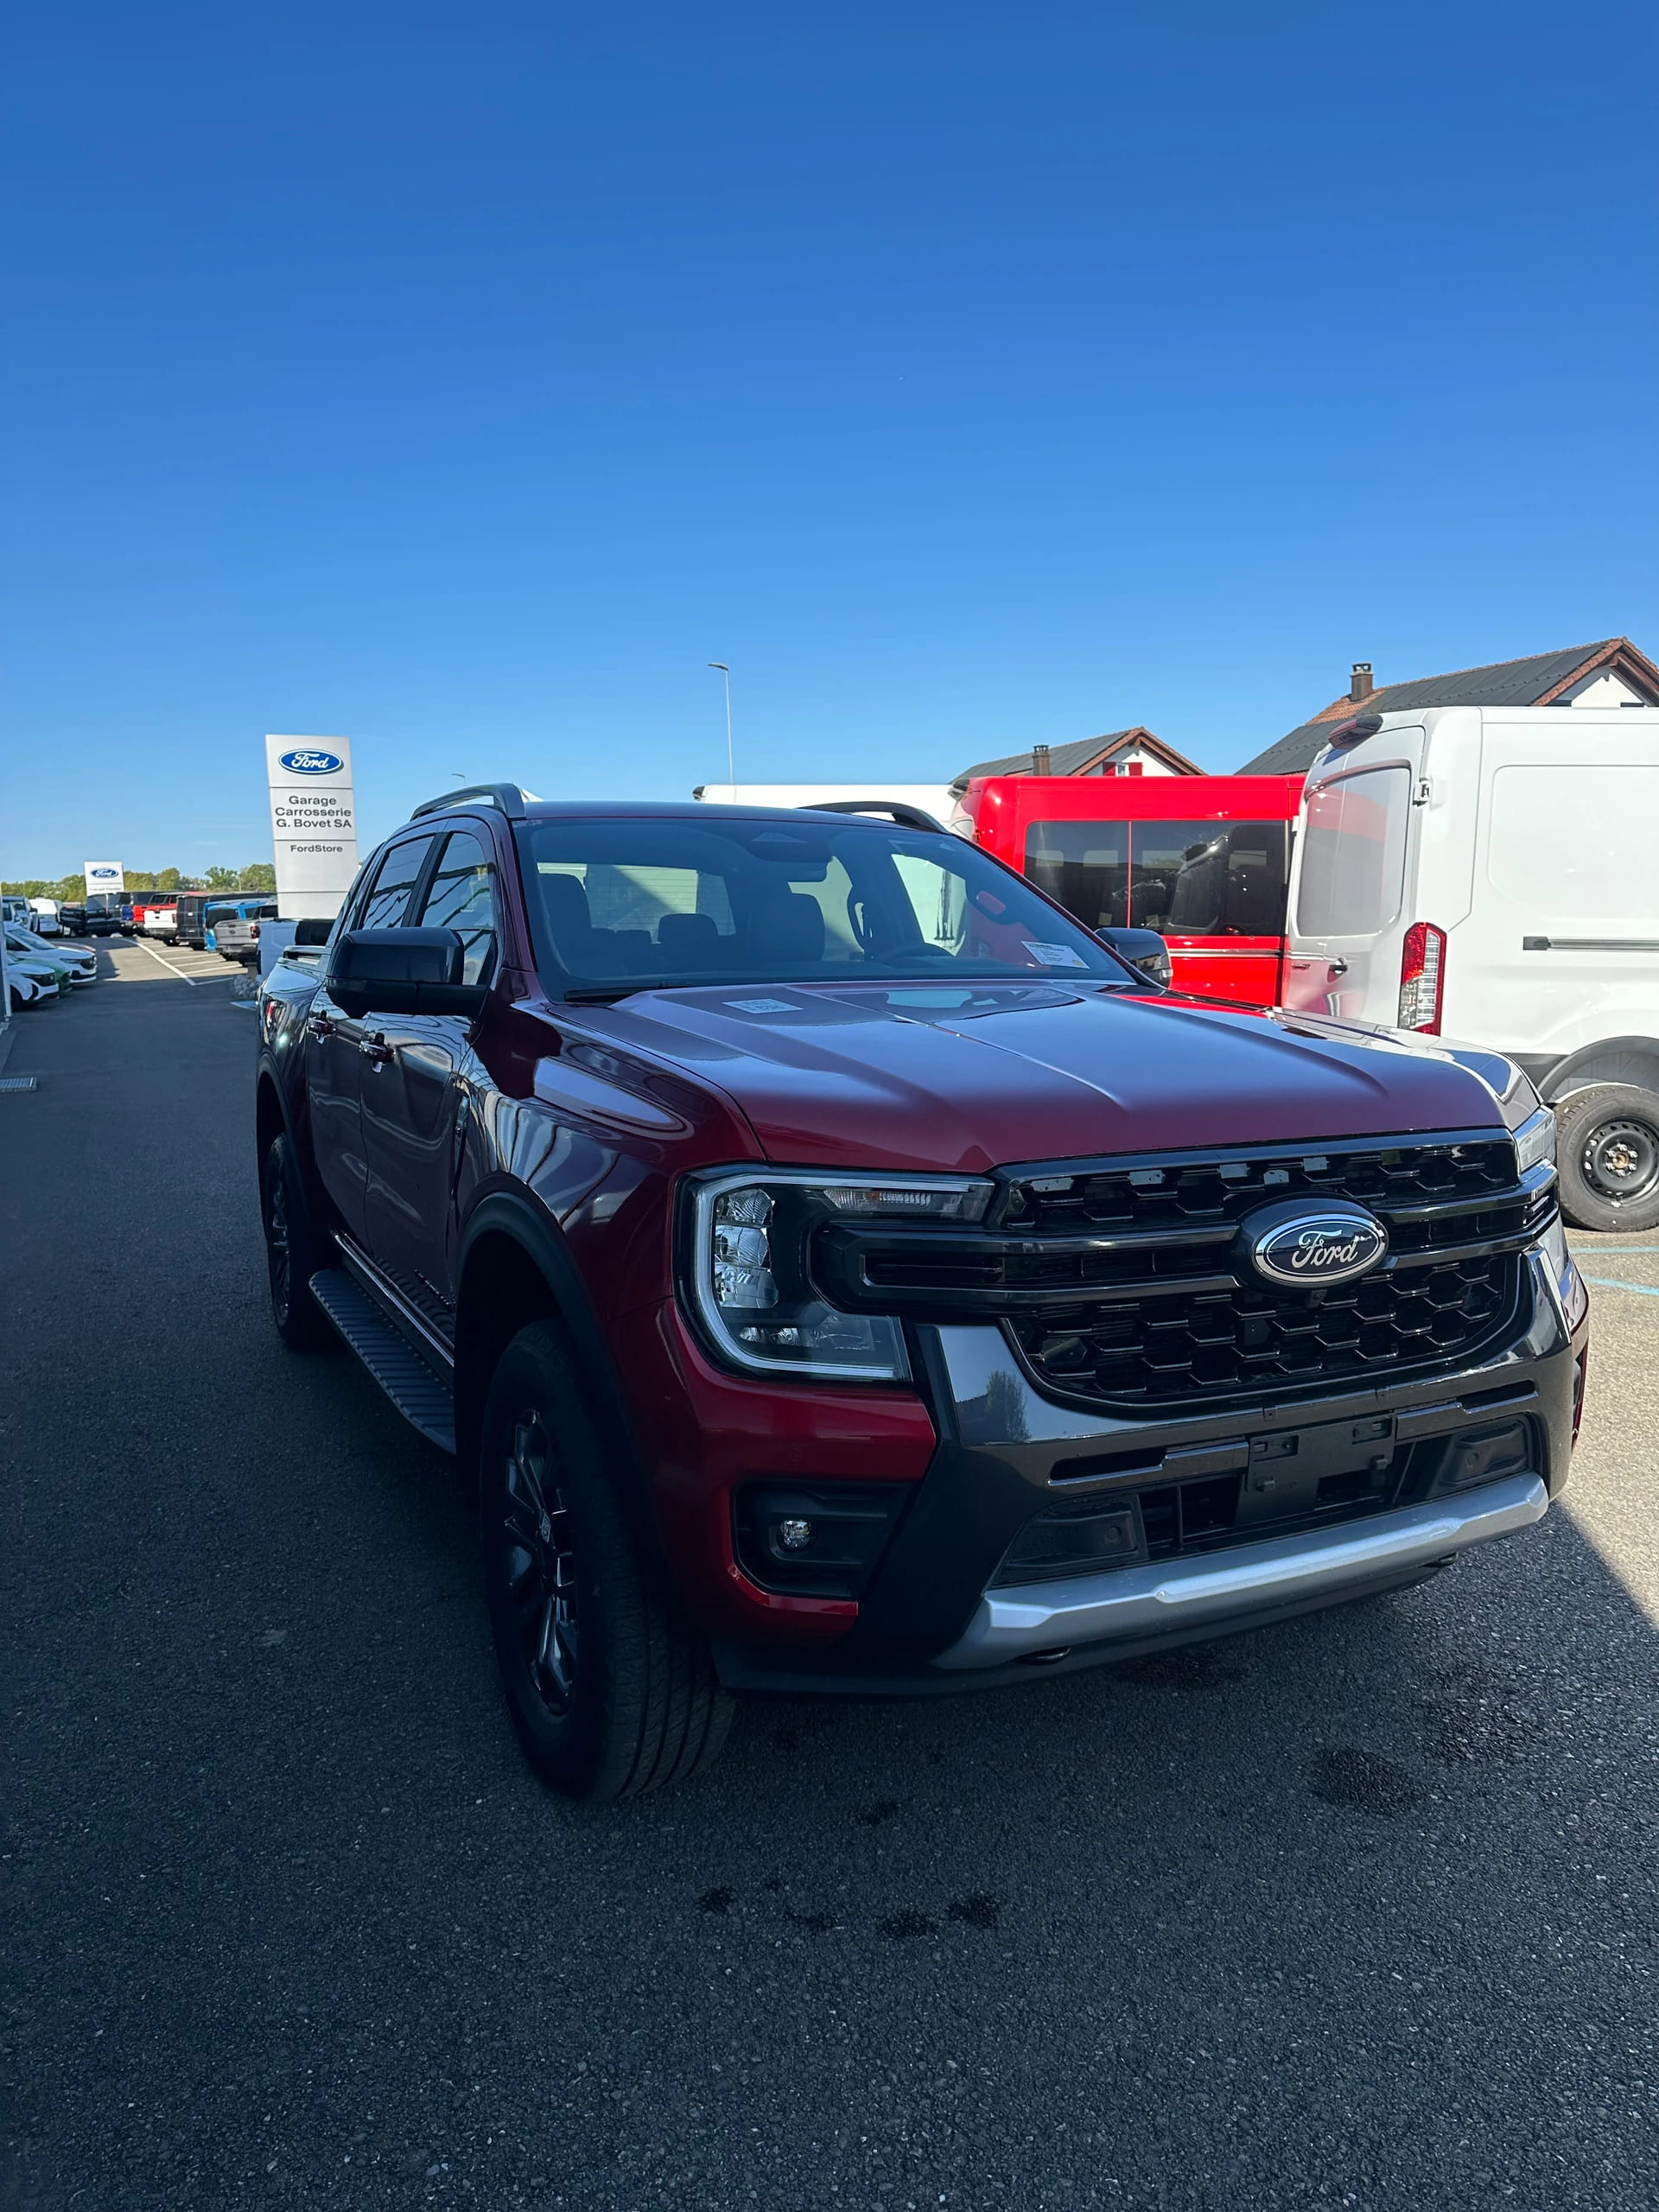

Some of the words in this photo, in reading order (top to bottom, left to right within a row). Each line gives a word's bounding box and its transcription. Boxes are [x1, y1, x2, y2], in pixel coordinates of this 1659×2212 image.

[291, 752, 329, 768] Ford
[289, 796, 337, 807] Garage
[275, 807, 352, 817] Carrosserie
[276, 818, 290, 828] G.
[294, 818, 332, 828] Bovet
[334, 819, 352, 828] SA
[290, 844, 343, 853] FordStore
[1291, 1229, 1359, 1268] Ford
